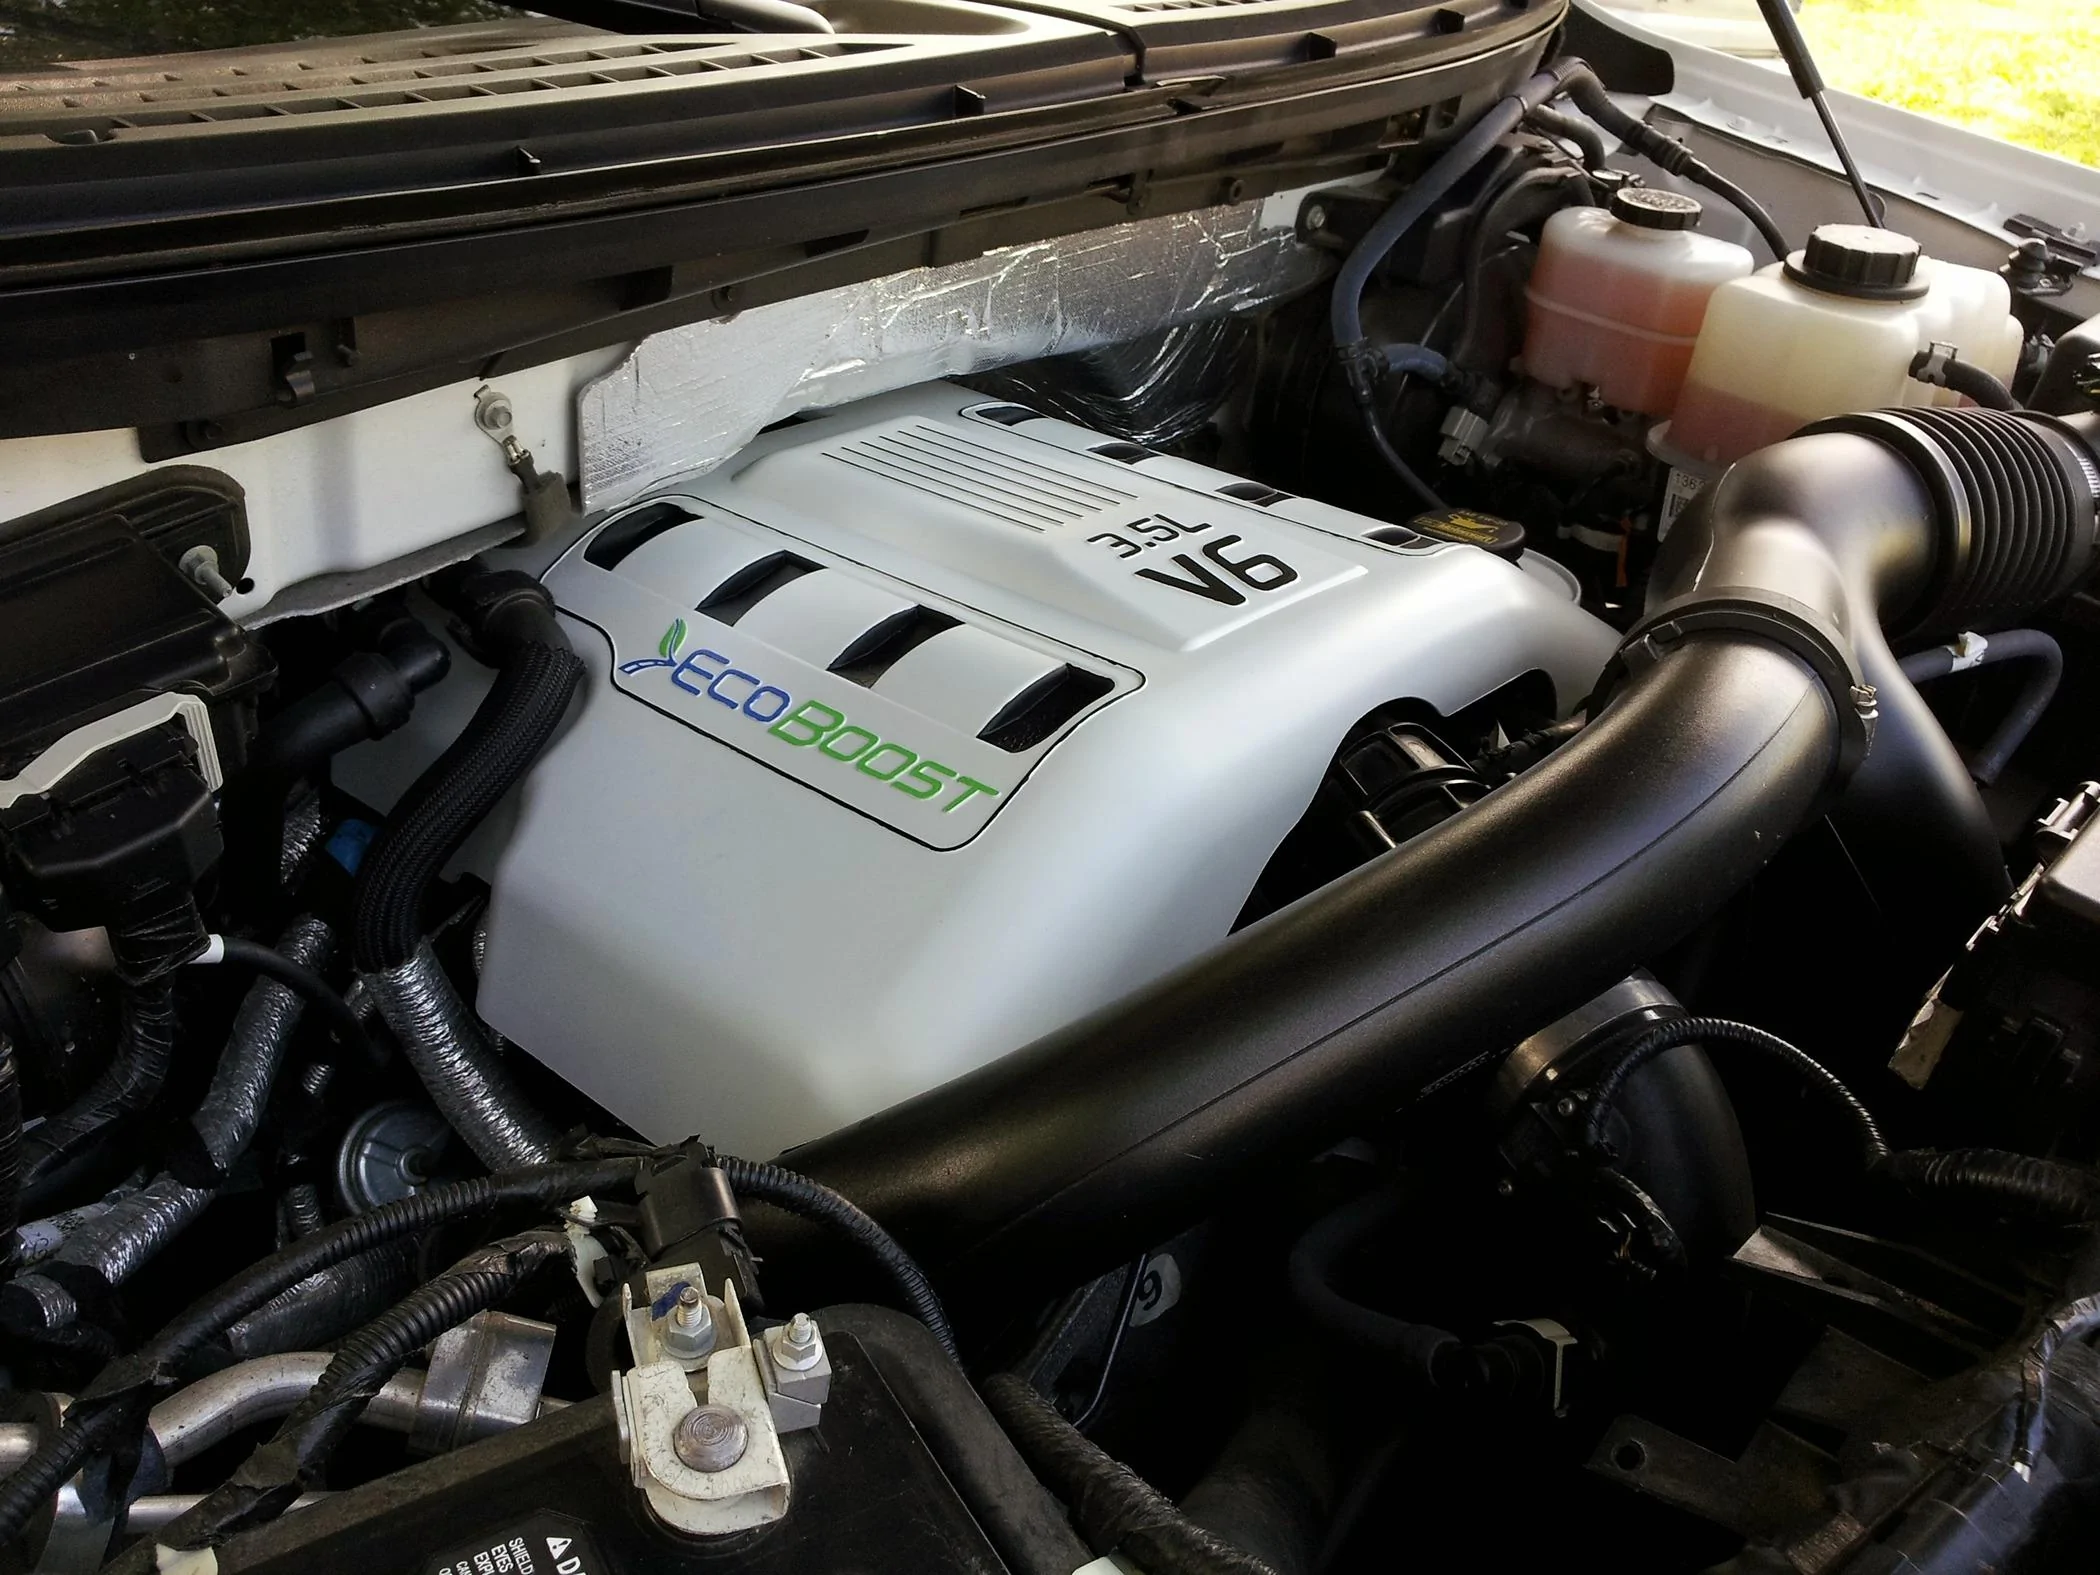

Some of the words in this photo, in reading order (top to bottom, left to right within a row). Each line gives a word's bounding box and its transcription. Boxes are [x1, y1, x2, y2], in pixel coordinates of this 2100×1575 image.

[1087, 513, 1213, 559] 3.5L
[1133, 534, 1299, 606] V6
[490, 1543, 514, 1574] EYES
[556, 1556, 587, 1575] D
